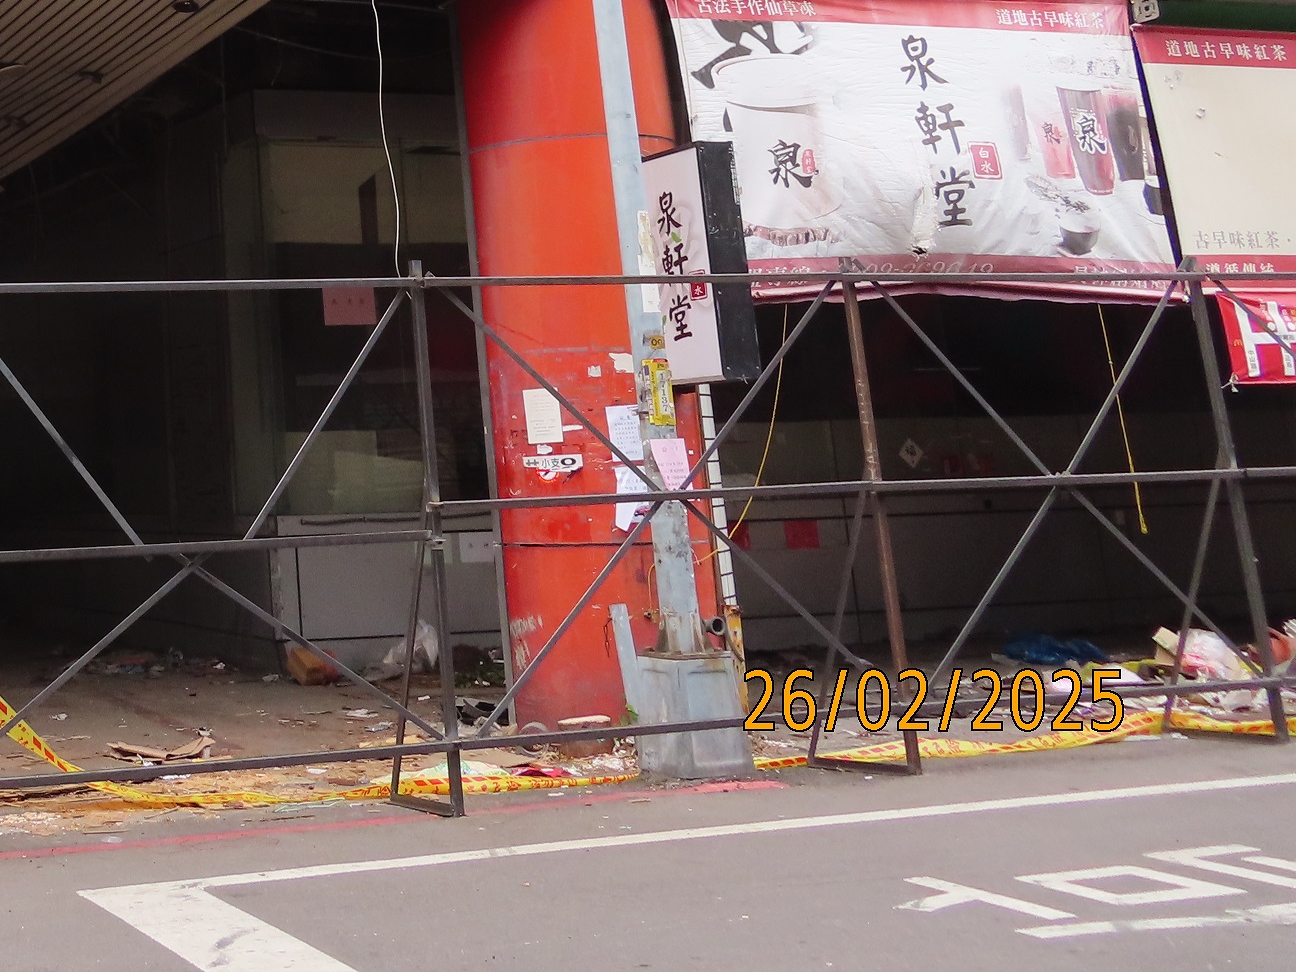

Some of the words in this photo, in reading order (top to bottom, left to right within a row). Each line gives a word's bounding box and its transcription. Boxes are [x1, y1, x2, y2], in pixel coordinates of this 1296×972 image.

[996, 8, 1104, 28] 道地古早味紅茶
[1164, 40, 1288, 63] 道地古早味紅茶
[900, 34, 975, 228] 泉軒堂
[1077, 115, 1107, 153] 泉
[767, 139, 814, 188] 泉
[978, 147, 995, 173] 白水
[1193, 230, 1280, 250] 古早味紅茶
[657, 191, 693, 342] 泉軒堂
